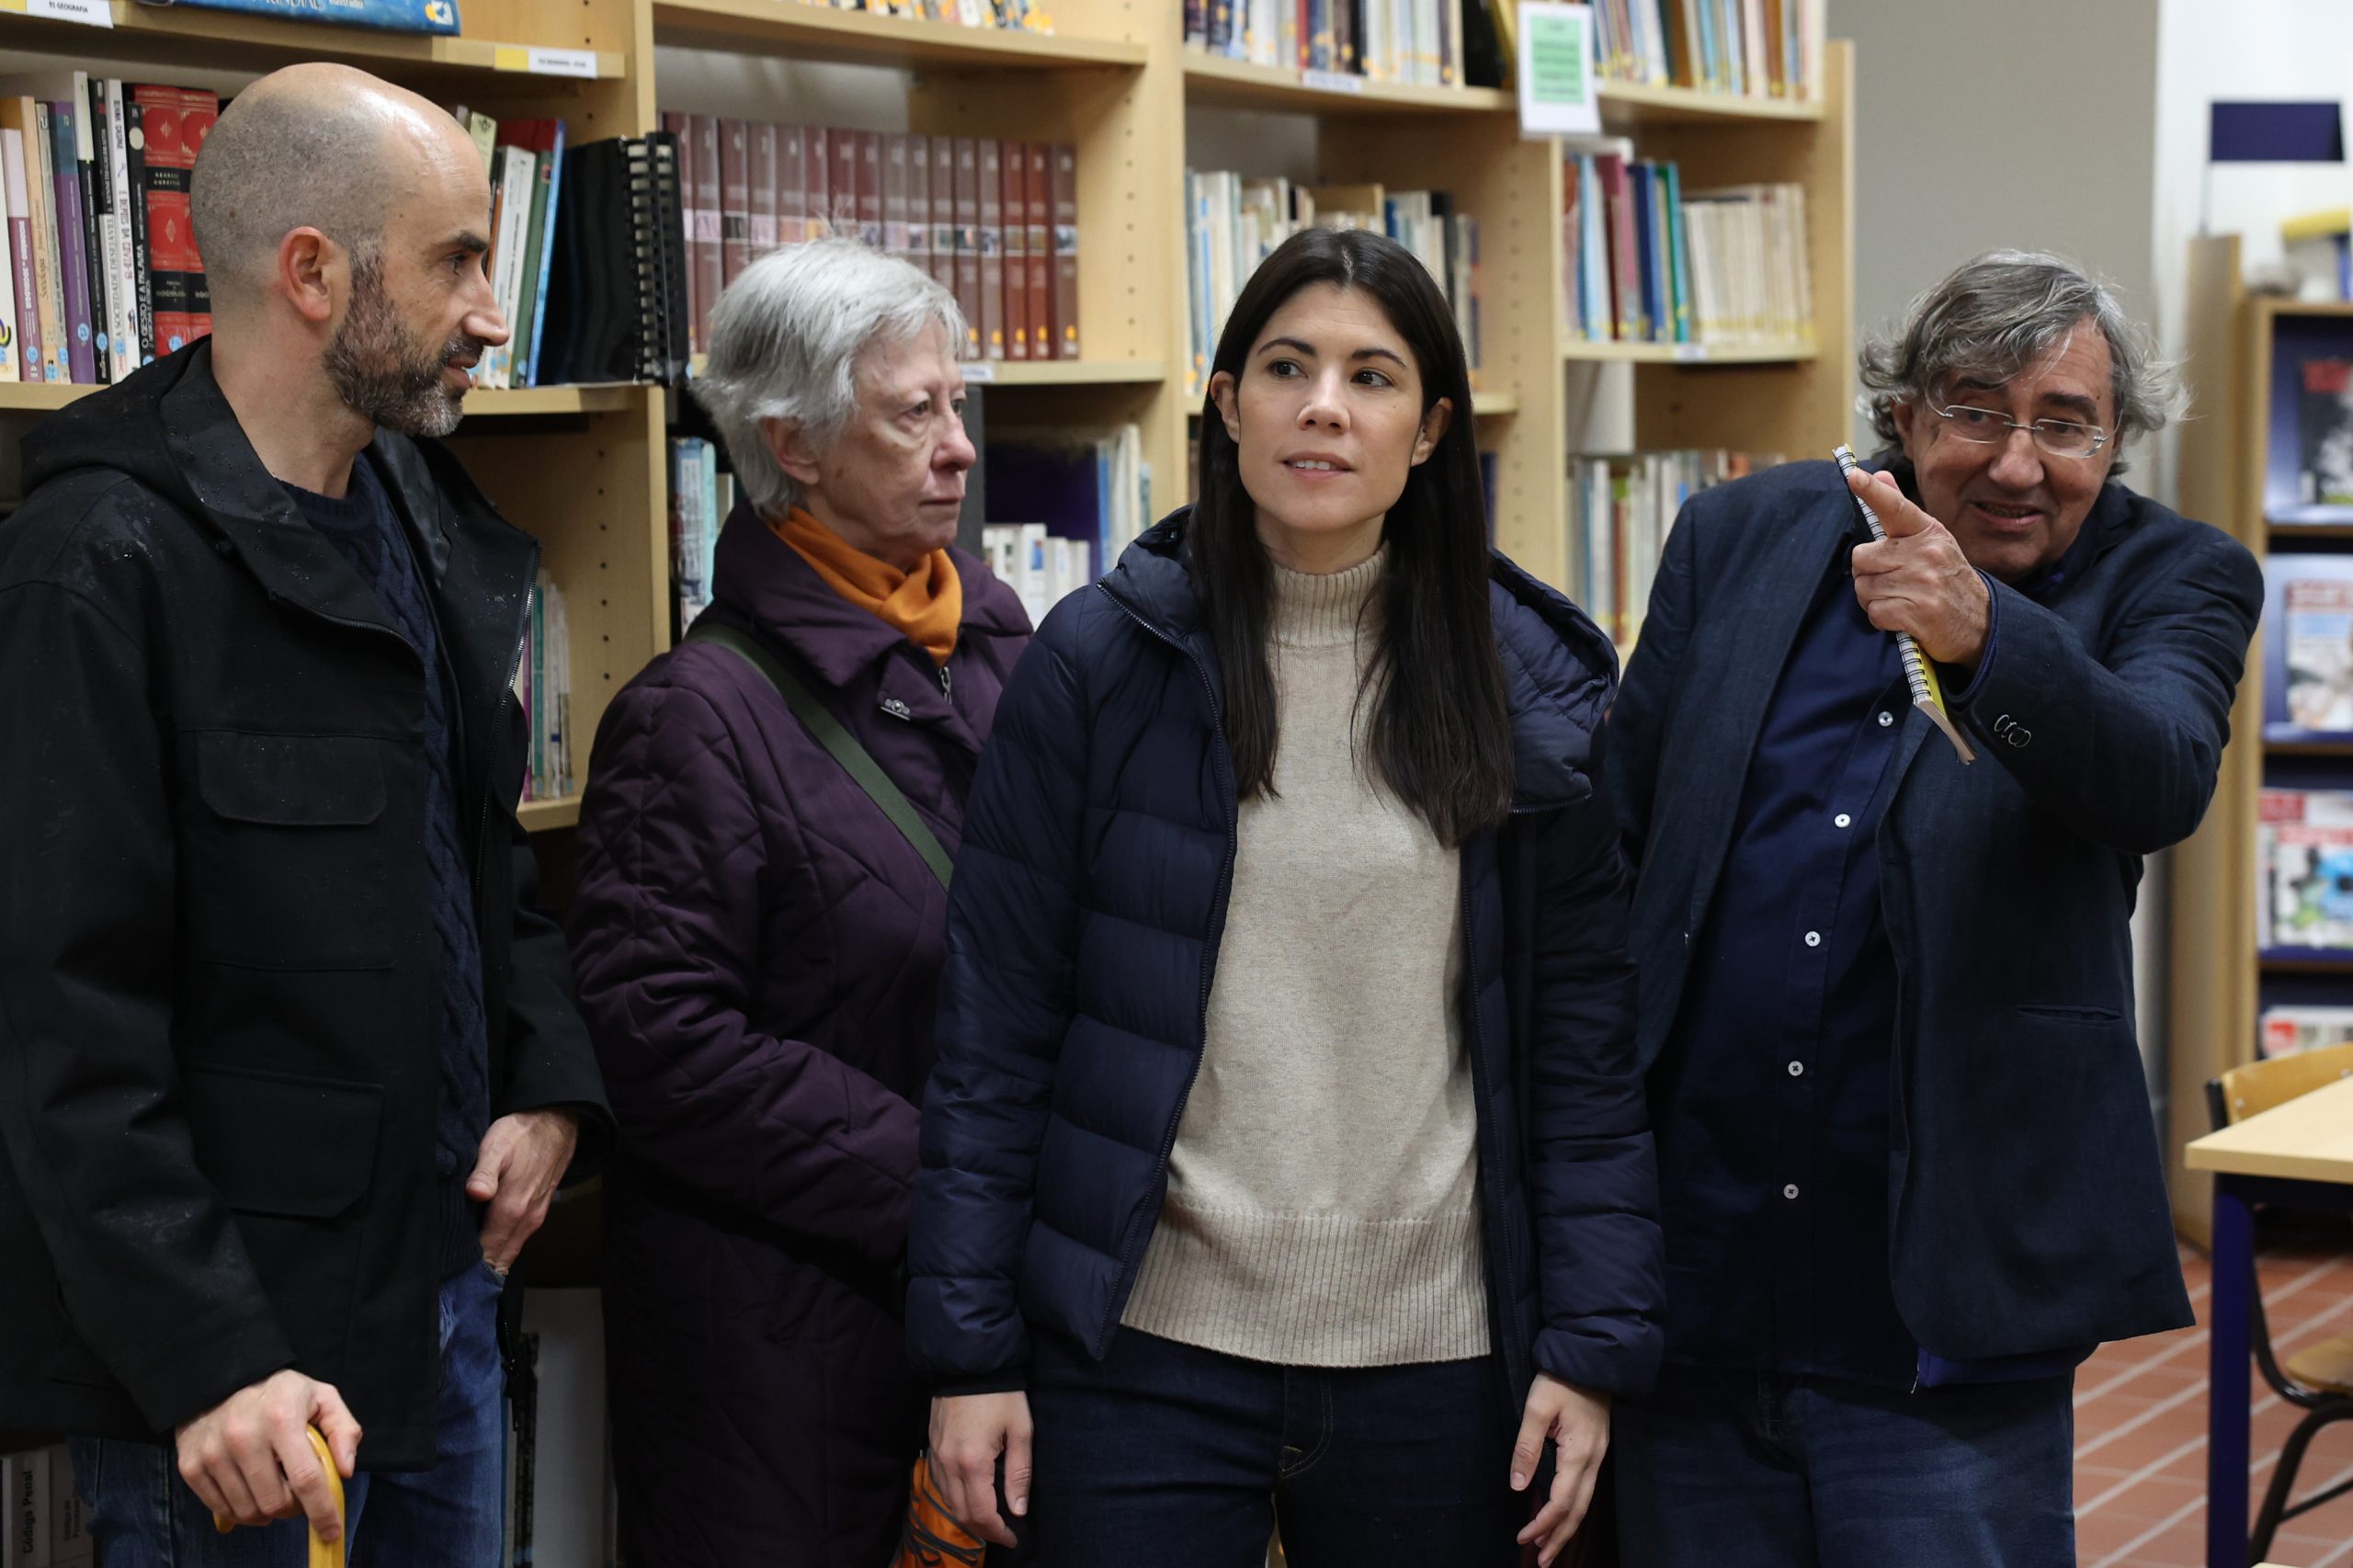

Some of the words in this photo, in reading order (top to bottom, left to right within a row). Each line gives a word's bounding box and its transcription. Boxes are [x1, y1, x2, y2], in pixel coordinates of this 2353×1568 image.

[56, 3, 89, 13] GEOGRAFIA
[38, 256, 50, 301] Sociologia
[121, 241, 133, 280] COVID-19
[135, 244, 145, 284] PALAVRA
[109, 273, 121, 330] SOCIEDADE
[138, 293, 147, 302] E
[139, 303, 148, 336] GESTO
[141, 337, 149, 349] O
[21, 1470, 33, 1506] Penal
[21, 1510, 36, 1554] Código
[62, 1512, 72, 1541] Código
[72, 1499, 81, 1539] Processo
